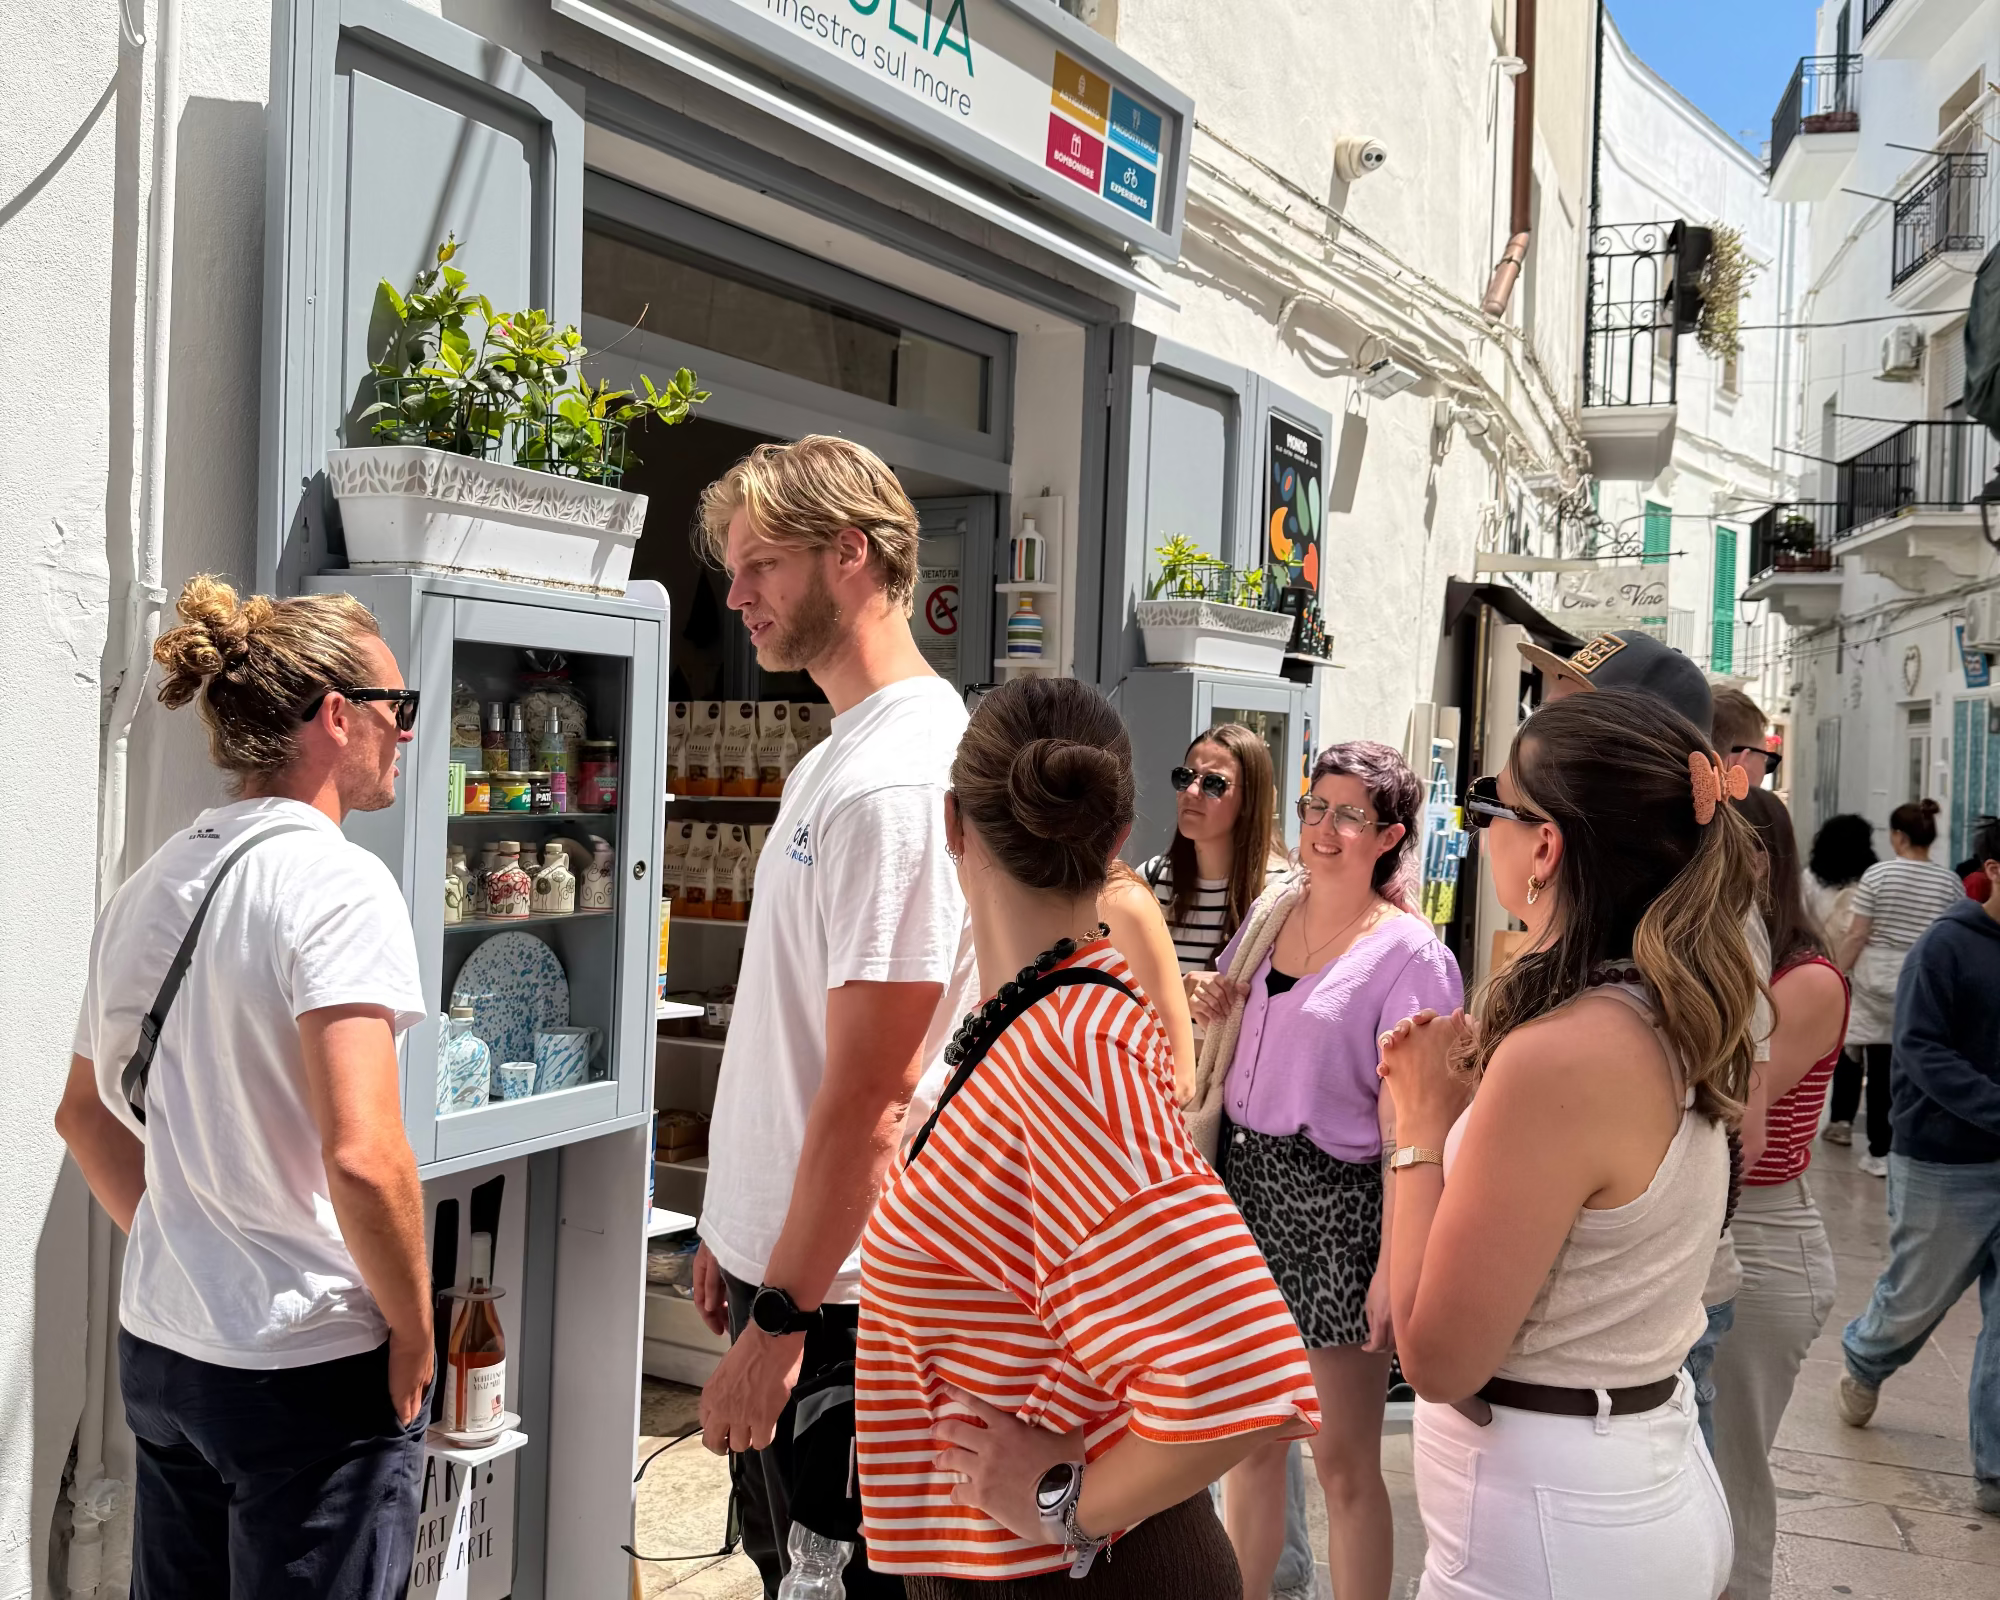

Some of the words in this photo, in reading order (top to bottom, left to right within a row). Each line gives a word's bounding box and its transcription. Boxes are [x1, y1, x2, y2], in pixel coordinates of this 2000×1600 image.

[849, 0, 975, 78] LIA
[767, 0, 866, 59] nestra
[874, 45, 906, 81] sul
[914, 66, 971, 115] mare
[1054, 150, 1094, 179] BOMBONIERE
[1110, 182, 1147, 209] EXPERIENCES
[922, 570, 947, 578] VIETATO
[1605, 597, 1616, 607] e
[1620, 582, 1666, 606] Vino
[459, 1497, 487, 1534] ART
[457, 1527, 493, 1570] ARTE
